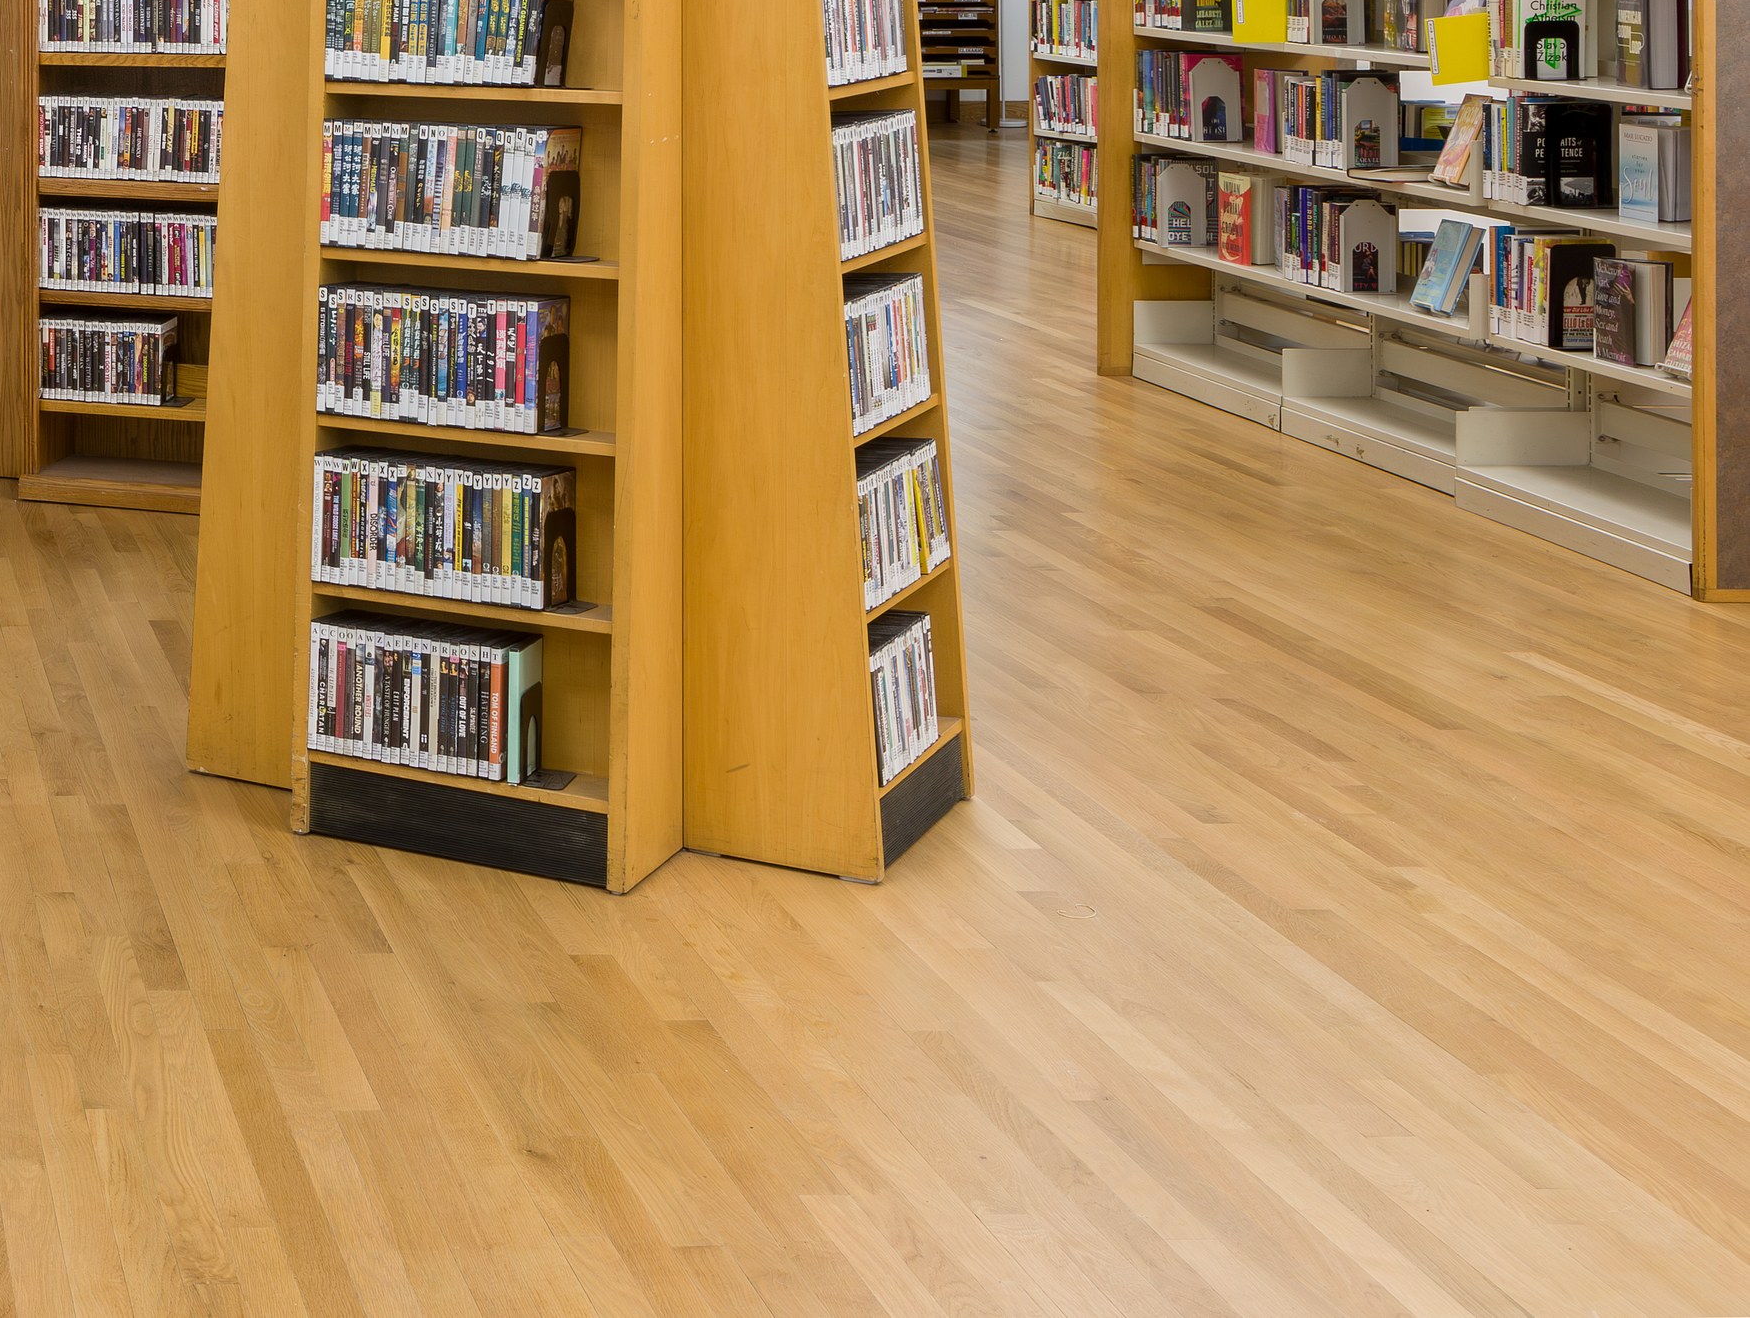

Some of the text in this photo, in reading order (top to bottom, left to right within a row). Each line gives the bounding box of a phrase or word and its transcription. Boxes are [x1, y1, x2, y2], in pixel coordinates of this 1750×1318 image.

[1530, 0, 1577, 11] Christian
[1532, 12, 1576, 22] Atheism
[1635, 133, 1653, 142] LUCADO
[1631, 154, 1648, 162] stories
[1223, 181, 1241, 194] INDIAN
[1622, 165, 1655, 203] Soul
[1609, 294, 1621, 305] and
[1595, 305, 1616, 319] Money,
[1606, 322, 1619, 332] and
[1604, 348, 1626, 362] Memoir
[369, 513, 378, 551] DISORDER
[354, 664, 363, 734] ANOTHER ROUND
[318, 681, 326, 734] CHARLATAN
[402, 678, 410, 739] ENFORCEMENT
[480, 691, 489, 744] HATCHING
[490, 722, 498, 754] FINLAND
